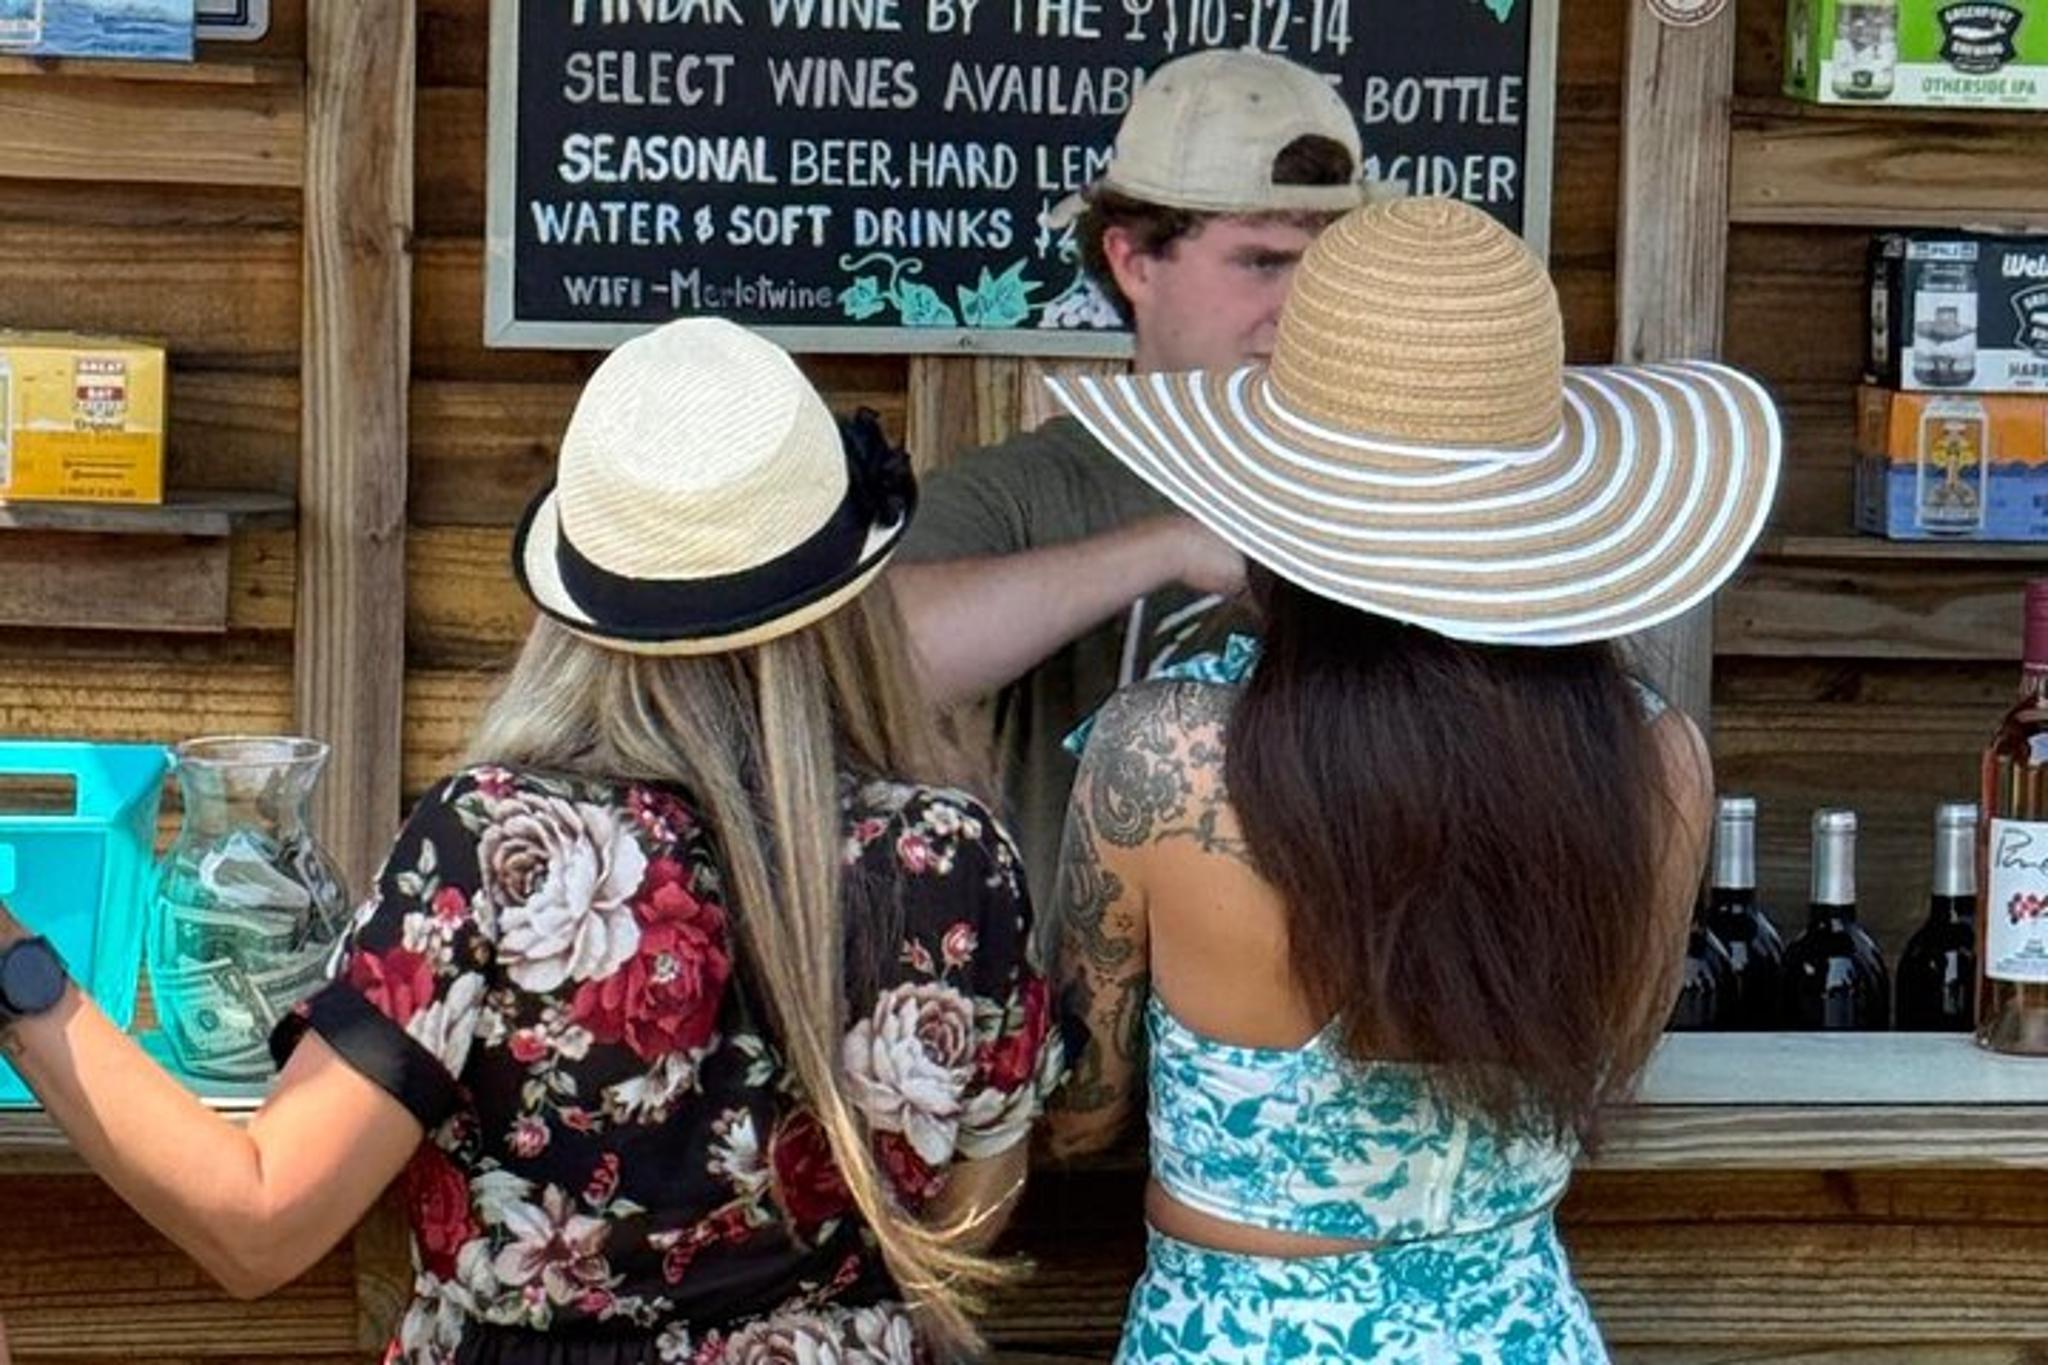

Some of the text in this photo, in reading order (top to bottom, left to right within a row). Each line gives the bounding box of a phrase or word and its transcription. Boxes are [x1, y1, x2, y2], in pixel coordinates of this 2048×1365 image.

[926, 0, 981, 36] BY
[563, 50, 735, 107] SELECT
[767, 56, 919, 110] WINES
[1363, 74, 1523, 125] BOTTLE
[1921, 76, 2038, 96] OTHERSIDE IPA
[557, 132, 778, 184] SEASONAL
[789, 139, 902, 189] BEER,
[908, 141, 1018, 190] HARD
[531, 200, 683, 246] WATER
[726, 204, 832, 247] SOFT
[854, 206, 1014, 249] DRINKS
[563, 274, 642, 306] WIFI
